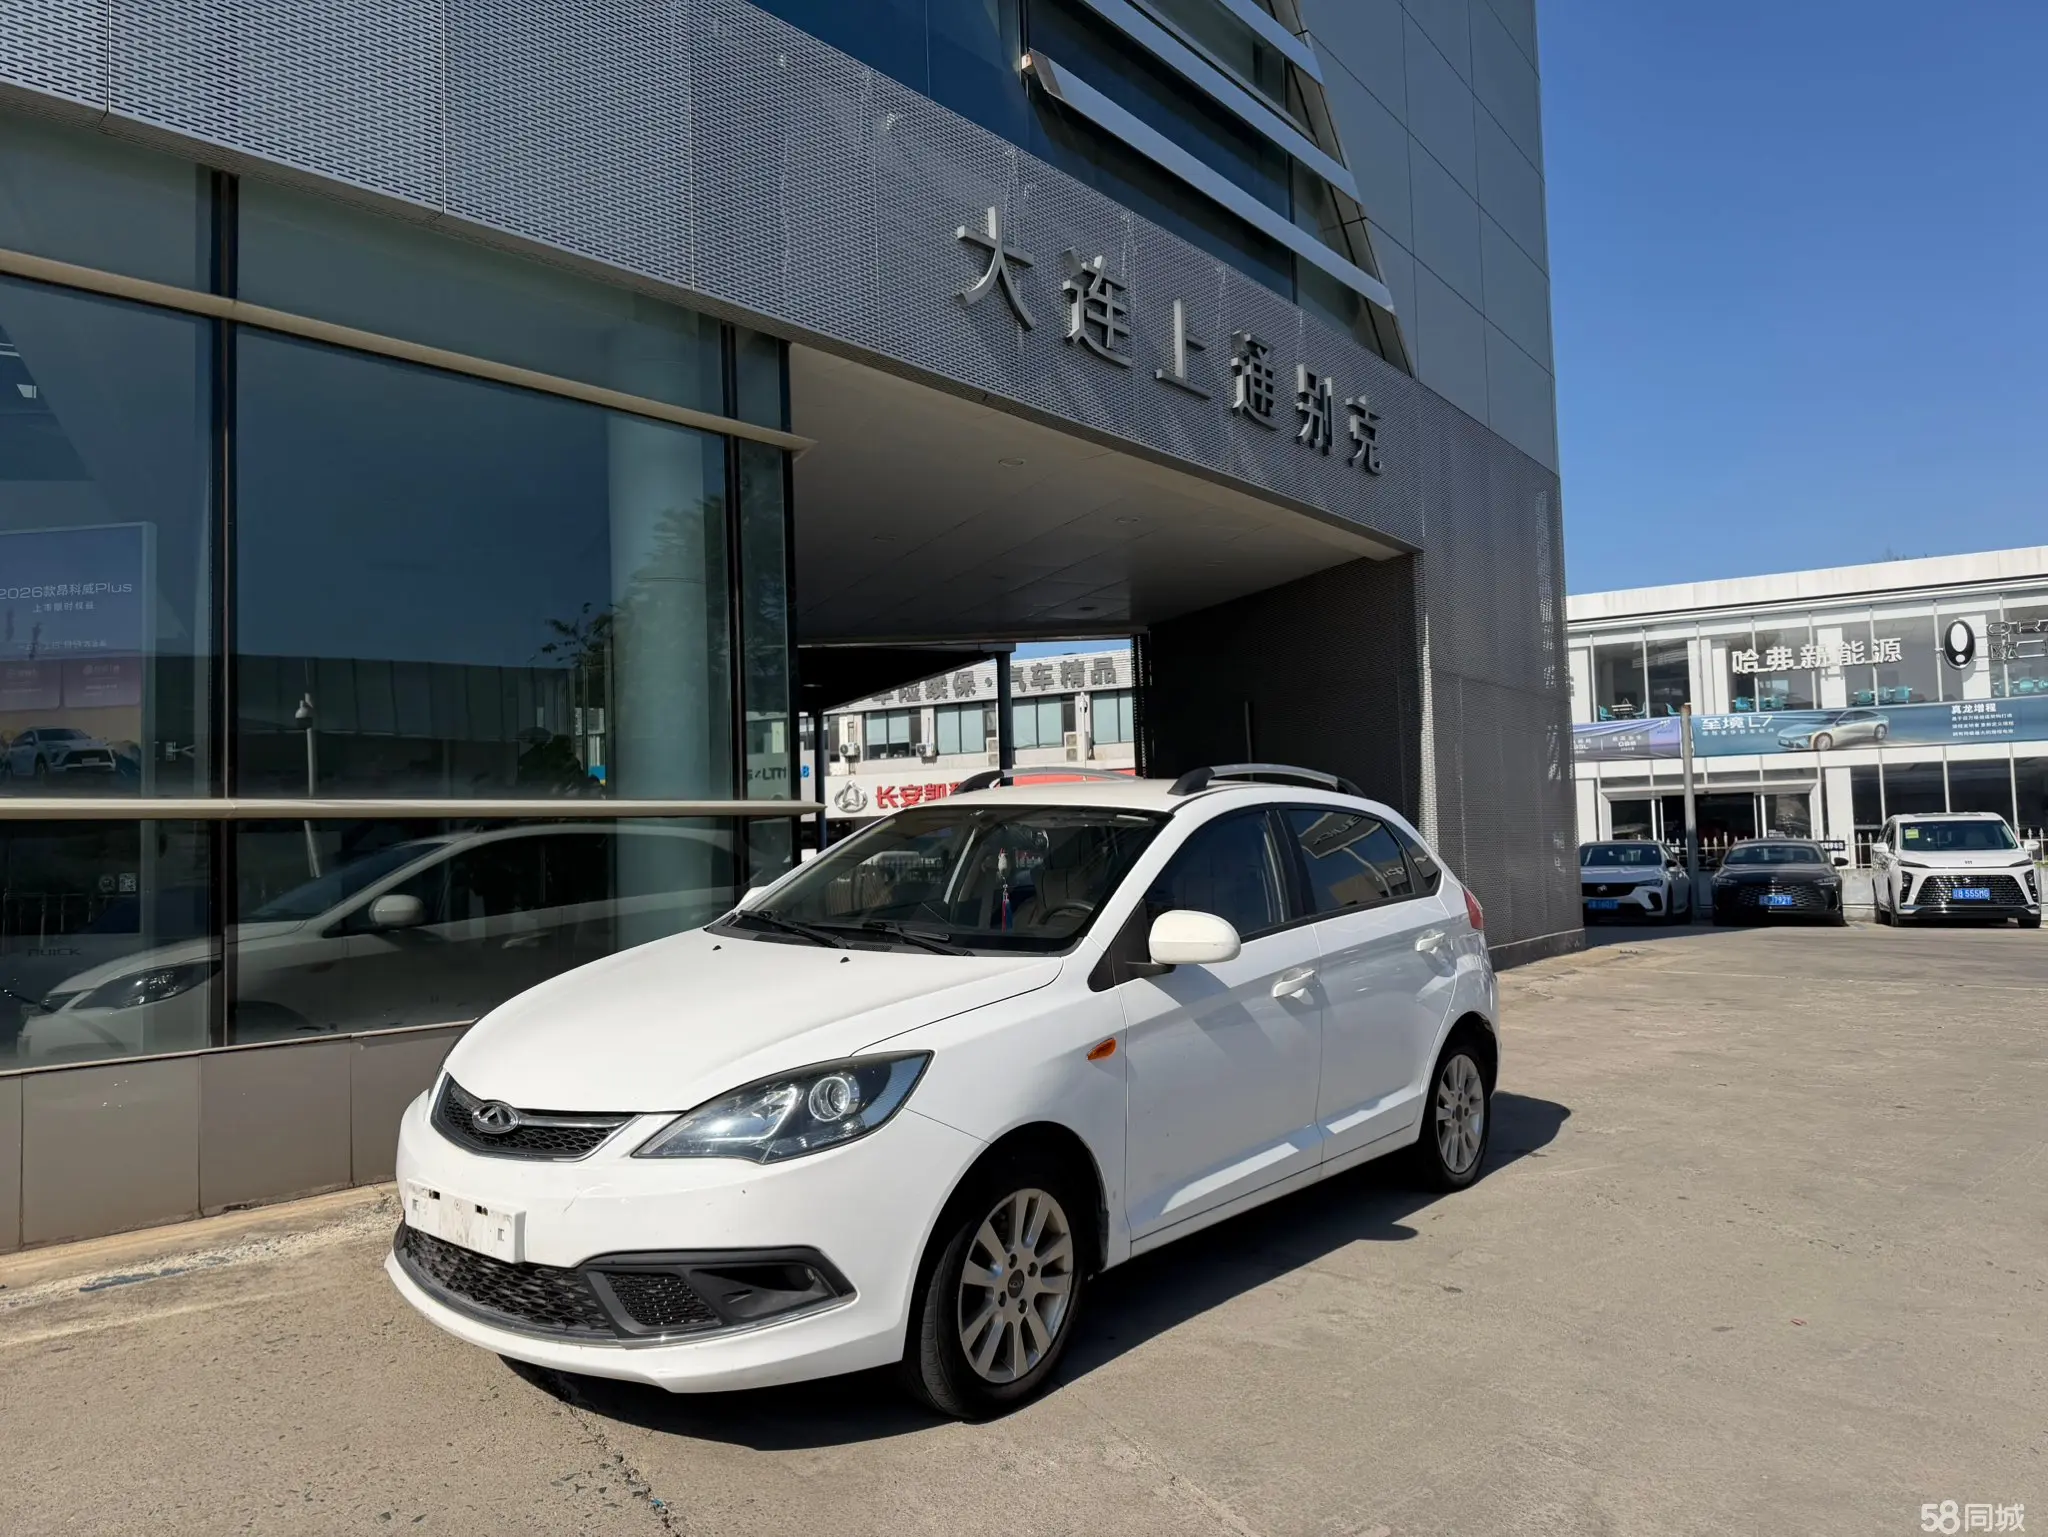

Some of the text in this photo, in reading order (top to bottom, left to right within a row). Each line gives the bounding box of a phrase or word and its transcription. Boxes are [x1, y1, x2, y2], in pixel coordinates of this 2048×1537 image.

[954, 205, 1383, 476] 大连上通别克
[1987, 618, 2048, 636] OR
[1731, 637, 1903, 675] 哈弗新能源
